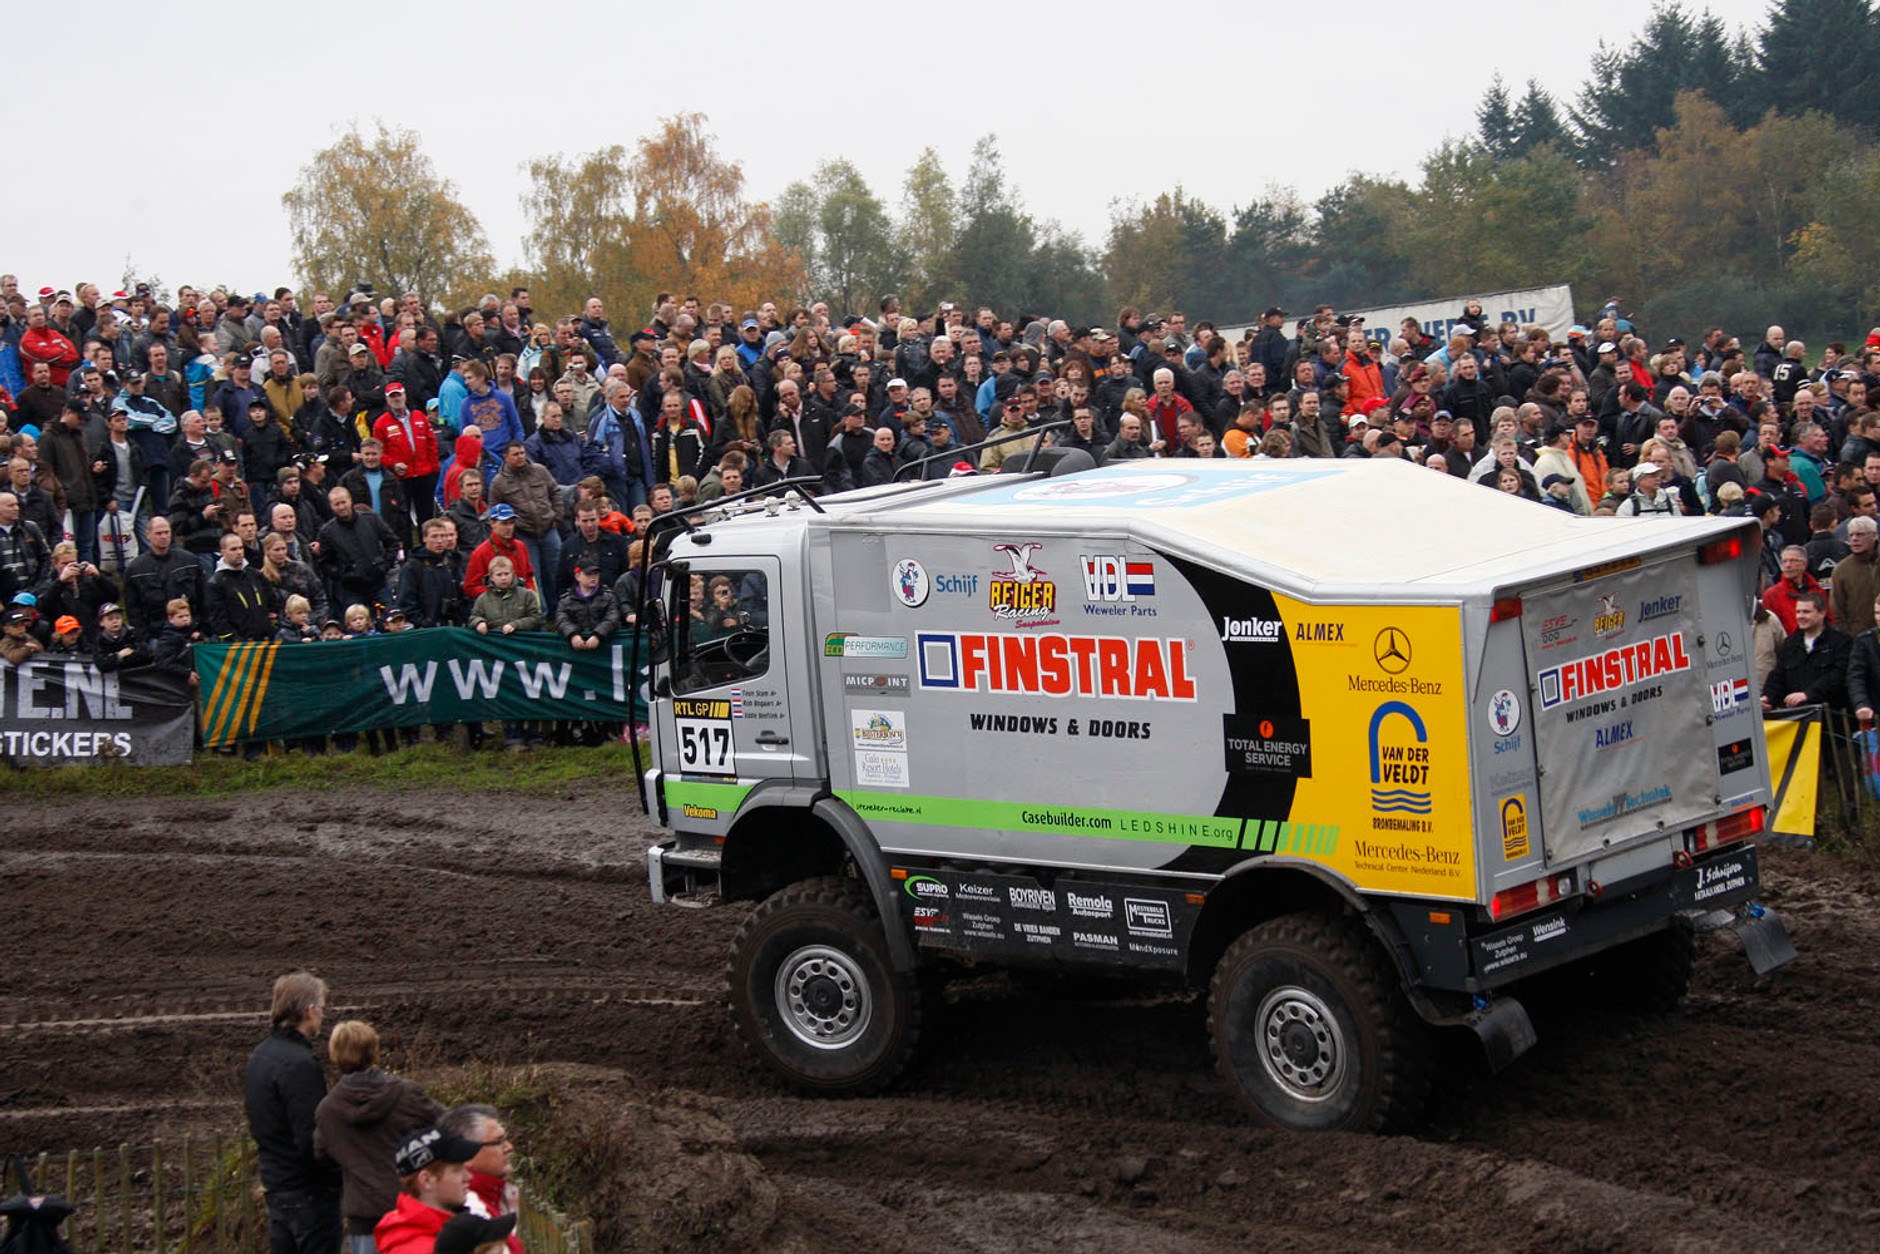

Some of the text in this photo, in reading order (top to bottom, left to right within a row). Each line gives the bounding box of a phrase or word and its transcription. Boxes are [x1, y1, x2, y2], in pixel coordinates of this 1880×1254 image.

[1773, 363, 1792, 381] 15
[936, 574, 978, 597] Schijf
[1080, 555, 1136, 602] VDL
[990, 581, 1056, 612] REIGER
[994, 604, 1051, 621] Racing
[1083, 605, 1157, 617] Weweler Parts
[1638, 594, 1683, 624] Jonker
[1221, 617, 1283, 641] Jonker
[1296, 623, 1345, 641] ALMEX
[844, 640, 905, 652] PERFORMANCE
[380, 645, 649, 704] www.l
[959, 632, 1197, 701] FINSTRAL
[1559, 631, 1692, 704] FINSTRAL
[1348, 675, 1442, 695] Mercedes-Benz
[1565, 685, 1664, 724] WINDOWS & DOORS
[1710, 678, 1740, 713] VDL
[674, 702, 710, 717] RTL GP
[970, 713, 1151, 740] WINDOWS & DOORS
[1595, 720, 1634, 750] ALMEX
[0, 731, 132, 757] TICKERS
[681, 726, 730, 767] 517
[1227, 738, 1308, 755] TOTAL ENERGY
[1494, 735, 1521, 754] Schijf
[1245, 752, 1291, 767] SERVICE
[1382, 745, 1429, 764] VAN DER
[1383, 763, 1430, 785] VELDT
[684, 804, 718, 820] Vekoma
[1021, 810, 1112, 829] Casebuilder.com
[1372, 817, 1434, 834] BRONBEMALING B.V.
[1508, 823, 1526, 837] VELDT
[1354, 840, 1461, 865] Mercedes-Benz
[1354, 860, 1462, 878] Technical Center Nederland B.V.
[916, 883, 949, 894] SUPRO
[959, 883, 994, 895] Keizer
[1009, 887, 1056, 905] BOYRIVEN
[1067, 892, 1113, 909] Remola
[1072, 908, 1112, 919] Autosport
[1139, 914, 1166, 925] TRUCKS
[1013, 923, 1022, 932] DE
[1022, 923, 1038, 934] VRIES
[1532, 916, 1566, 937] Wensink
[1073, 931, 1119, 946] PASMAN
